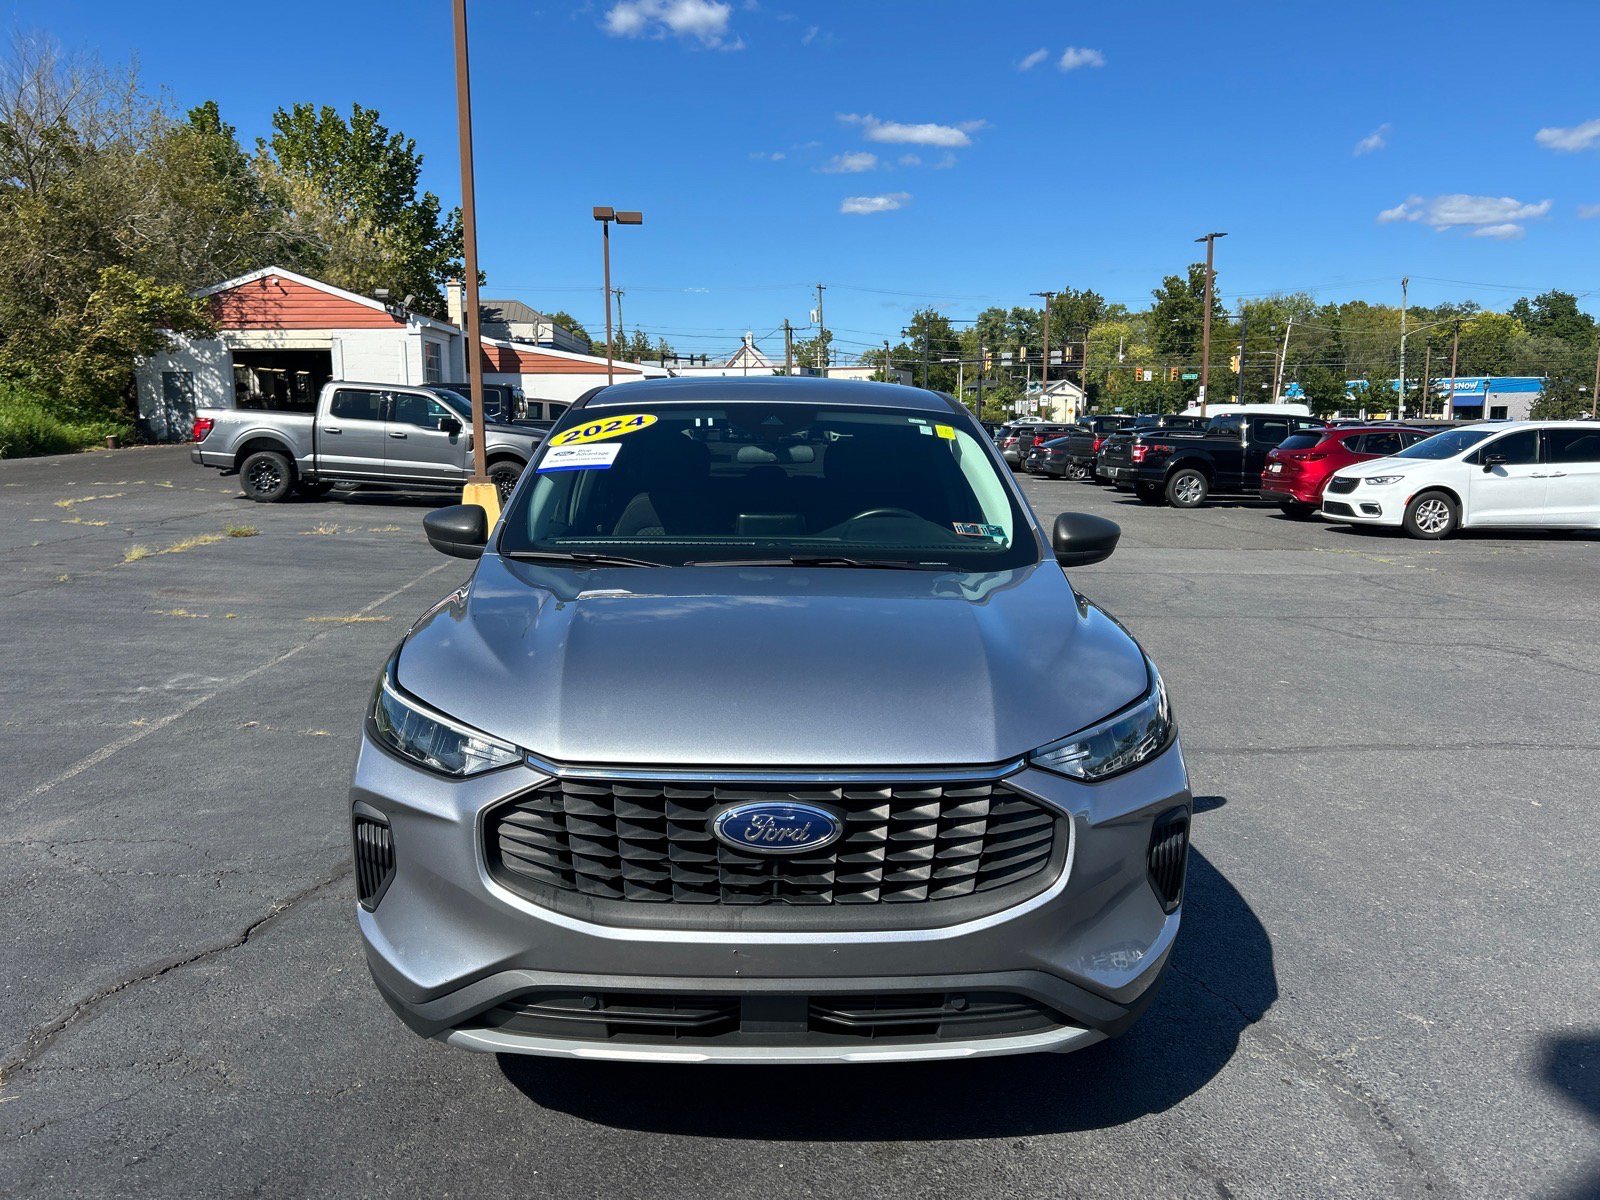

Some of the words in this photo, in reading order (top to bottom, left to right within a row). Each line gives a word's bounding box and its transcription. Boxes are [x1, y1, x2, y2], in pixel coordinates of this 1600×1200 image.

[1436, 381, 1478, 390] lasNow
[561, 415, 645, 444] 2024
[744, 814, 812, 842] Ford
